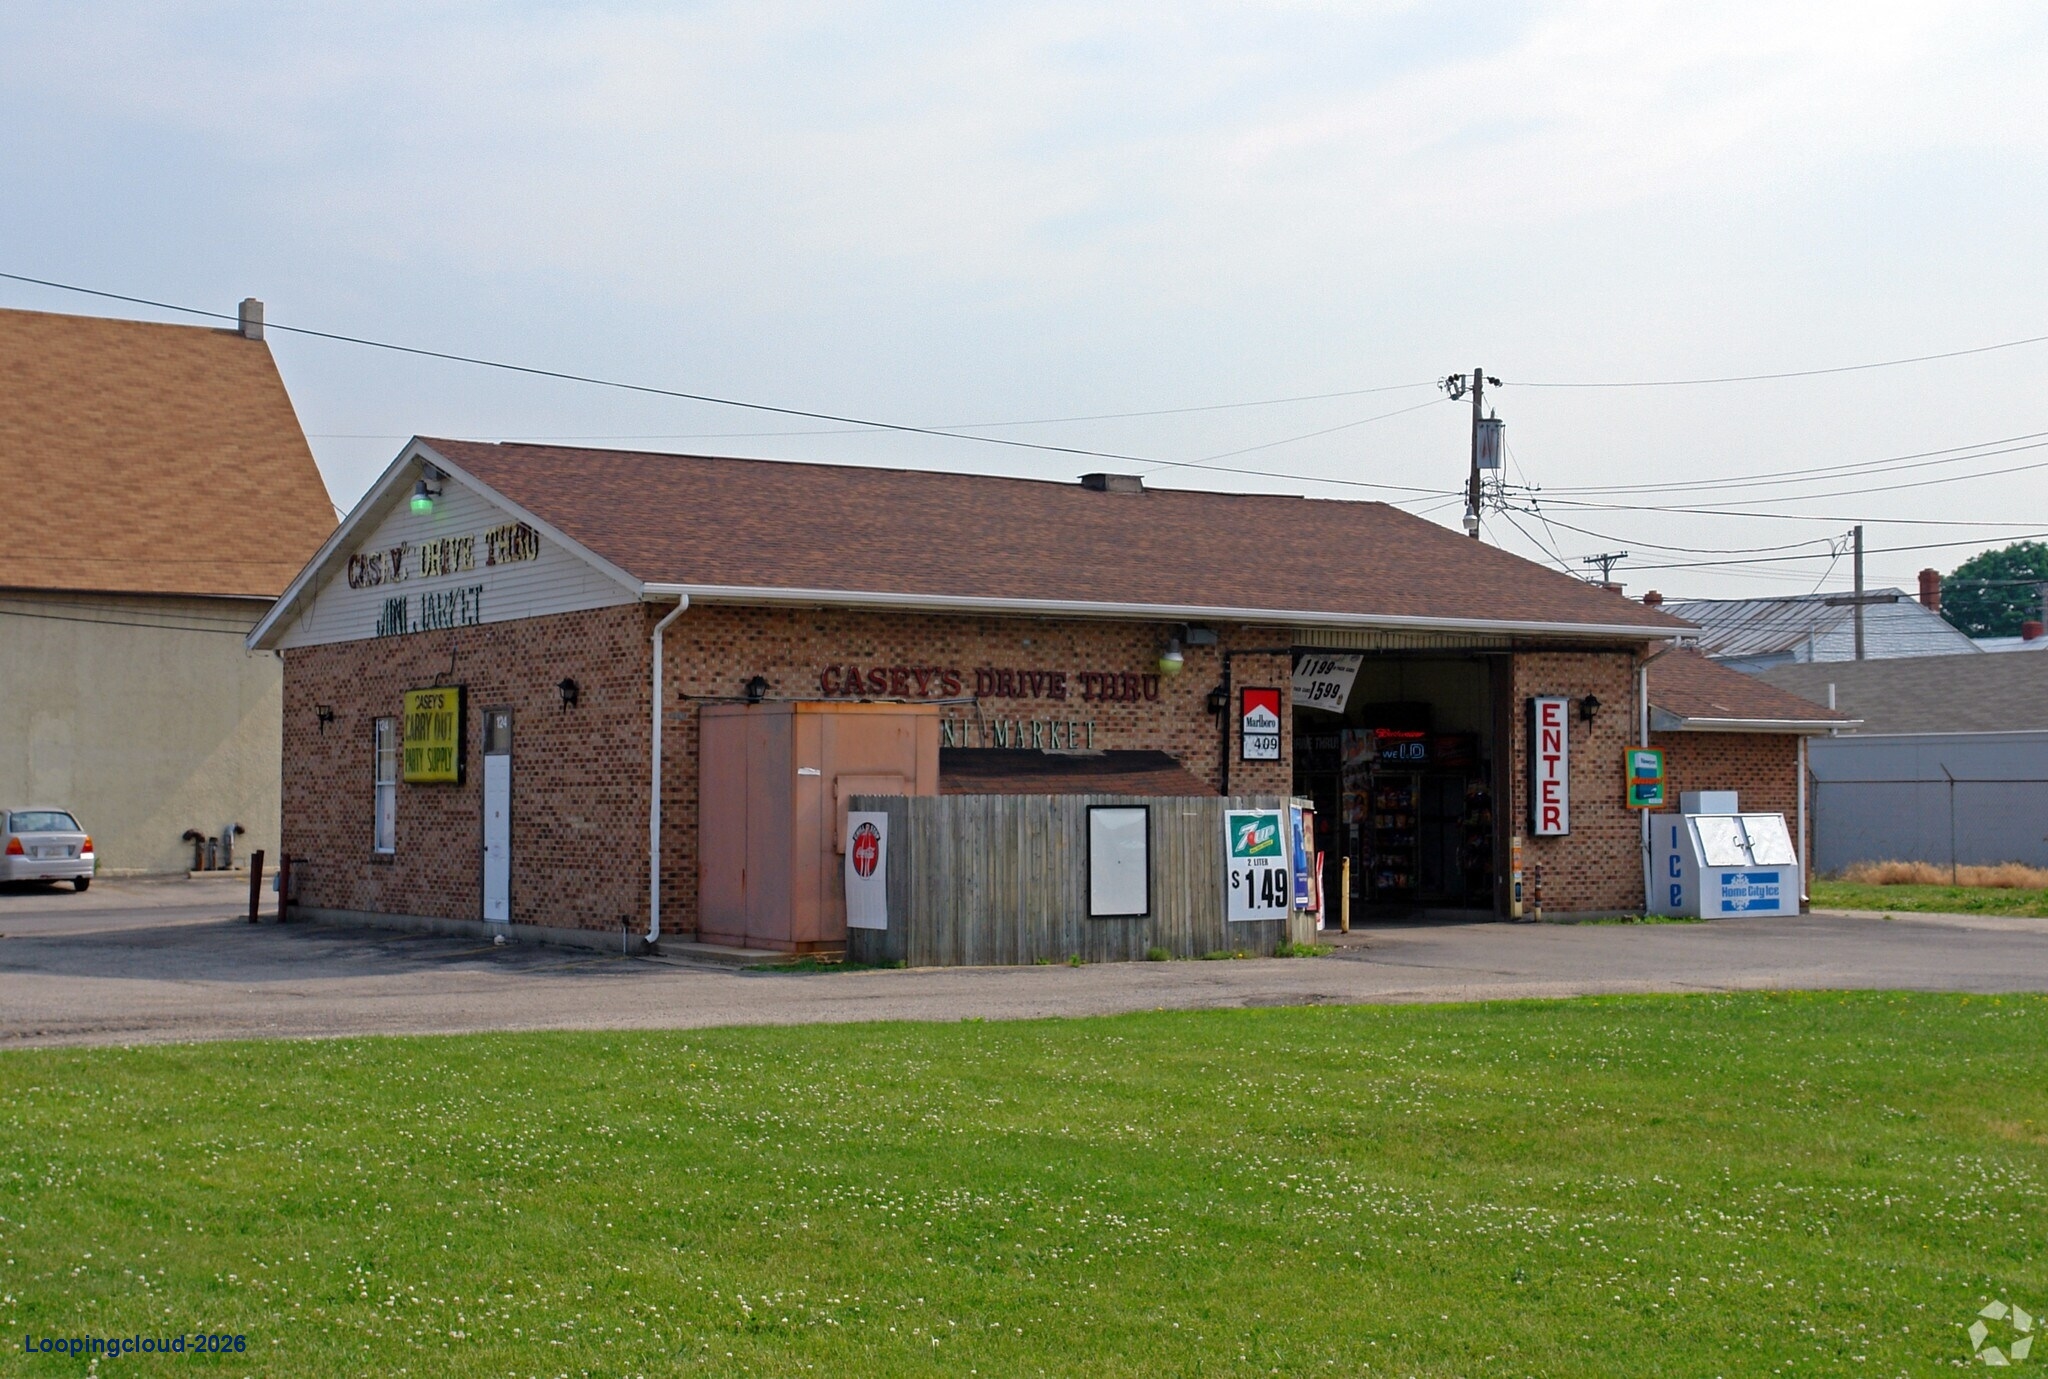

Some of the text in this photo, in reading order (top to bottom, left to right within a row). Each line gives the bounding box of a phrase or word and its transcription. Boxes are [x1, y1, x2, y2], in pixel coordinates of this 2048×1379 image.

[820, 663, 1161, 701] CASEY'S DRIVE THRU
[415, 694, 445, 710] CASEY'S
[405, 712, 454, 741] CARRY OUT
[496, 716, 507, 729] 124
[1246, 714, 1276, 728] Marlboro
[942, 719, 1095, 749] NI MARKET
[1254, 737, 1277, 750] 409
[405, 747, 453, 772] PARTY SUPPLY
[1543, 703, 1561, 831] ENTER
[1247, 858, 1268, 867] 2 LITER
[1245, 868, 1287, 909] 1.49
[1722, 885, 1779, 899] Home City Ice
